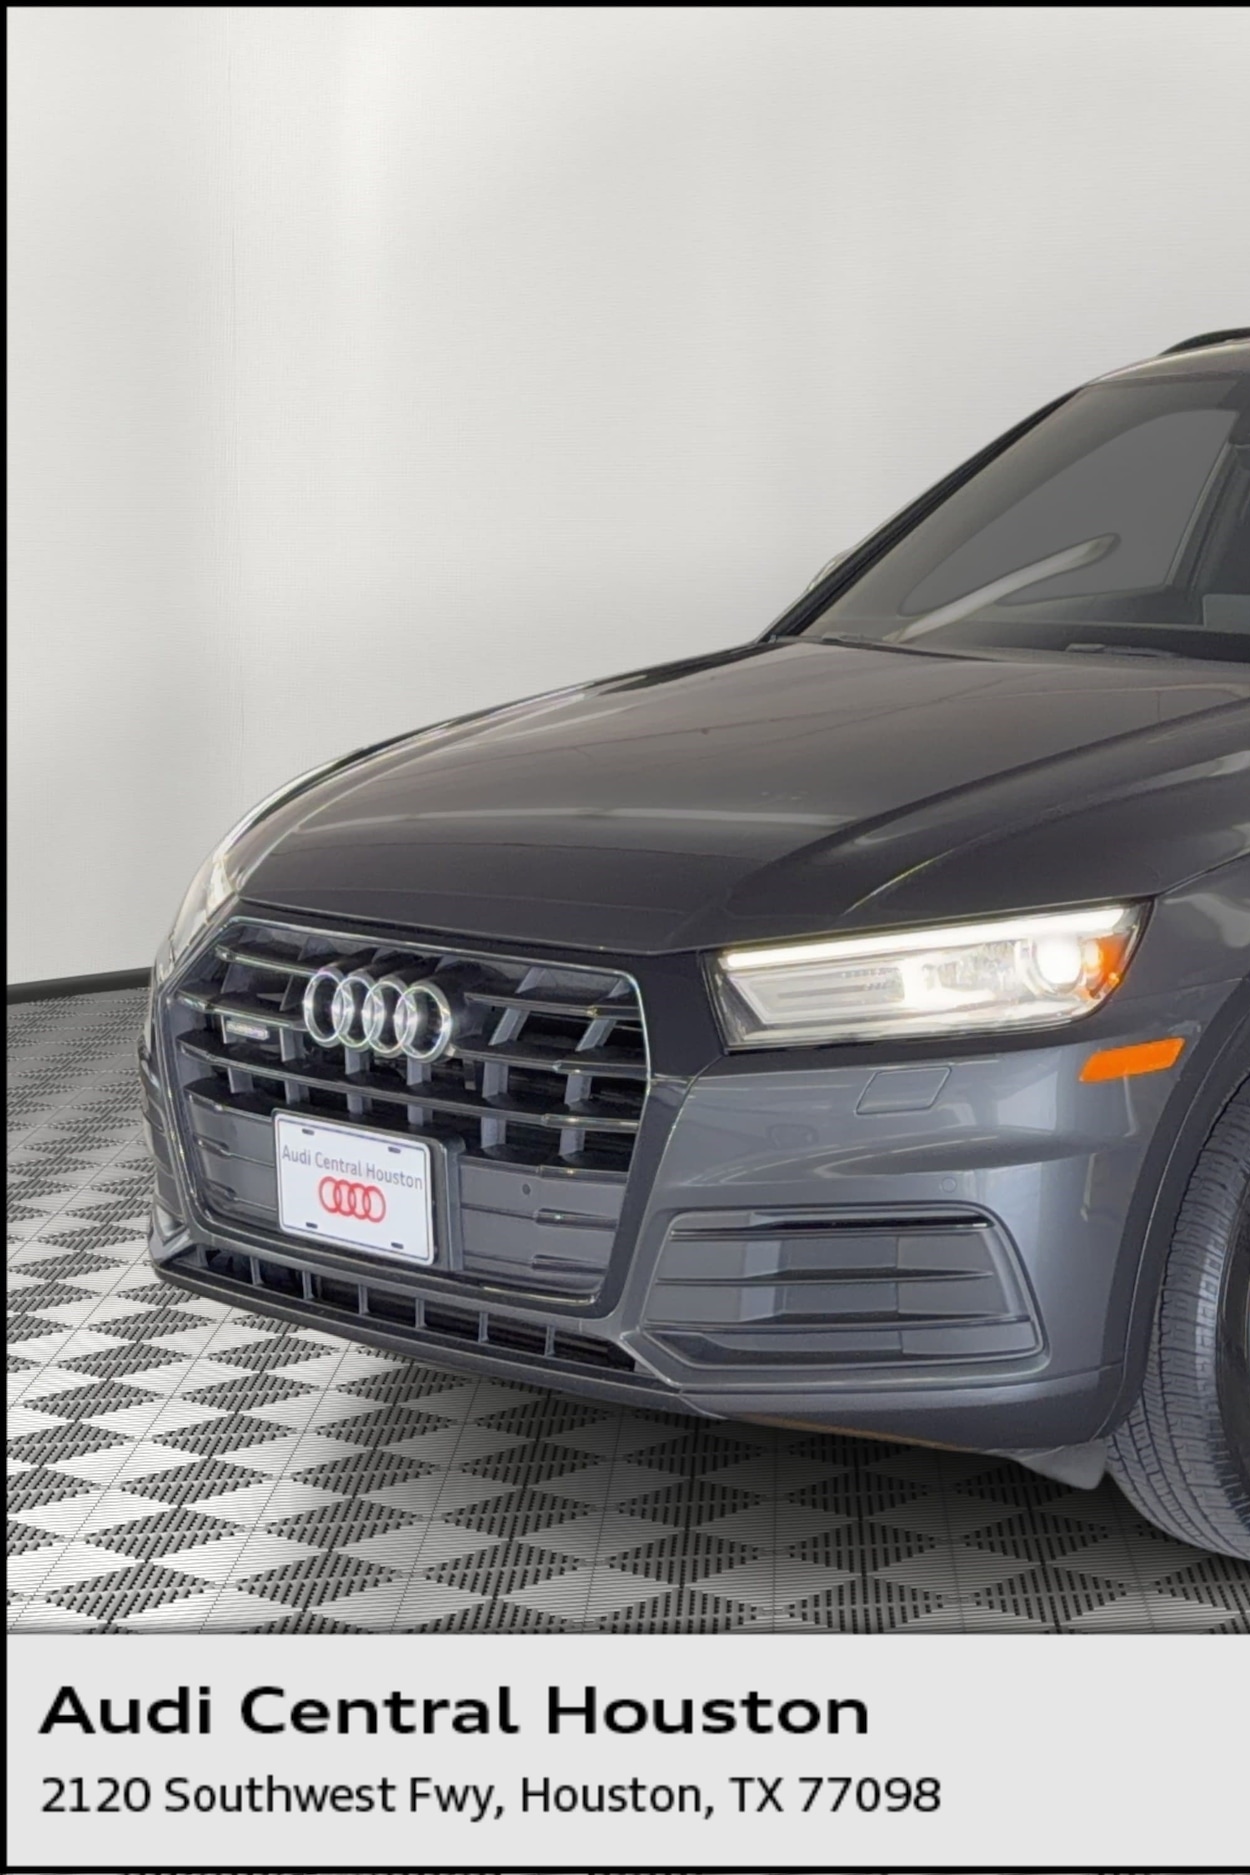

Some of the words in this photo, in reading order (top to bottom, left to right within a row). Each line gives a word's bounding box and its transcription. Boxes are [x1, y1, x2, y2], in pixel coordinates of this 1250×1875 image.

[282, 1145, 311, 1166] Audi
[315, 1152, 362, 1177] Central
[366, 1162, 423, 1190] Houston
